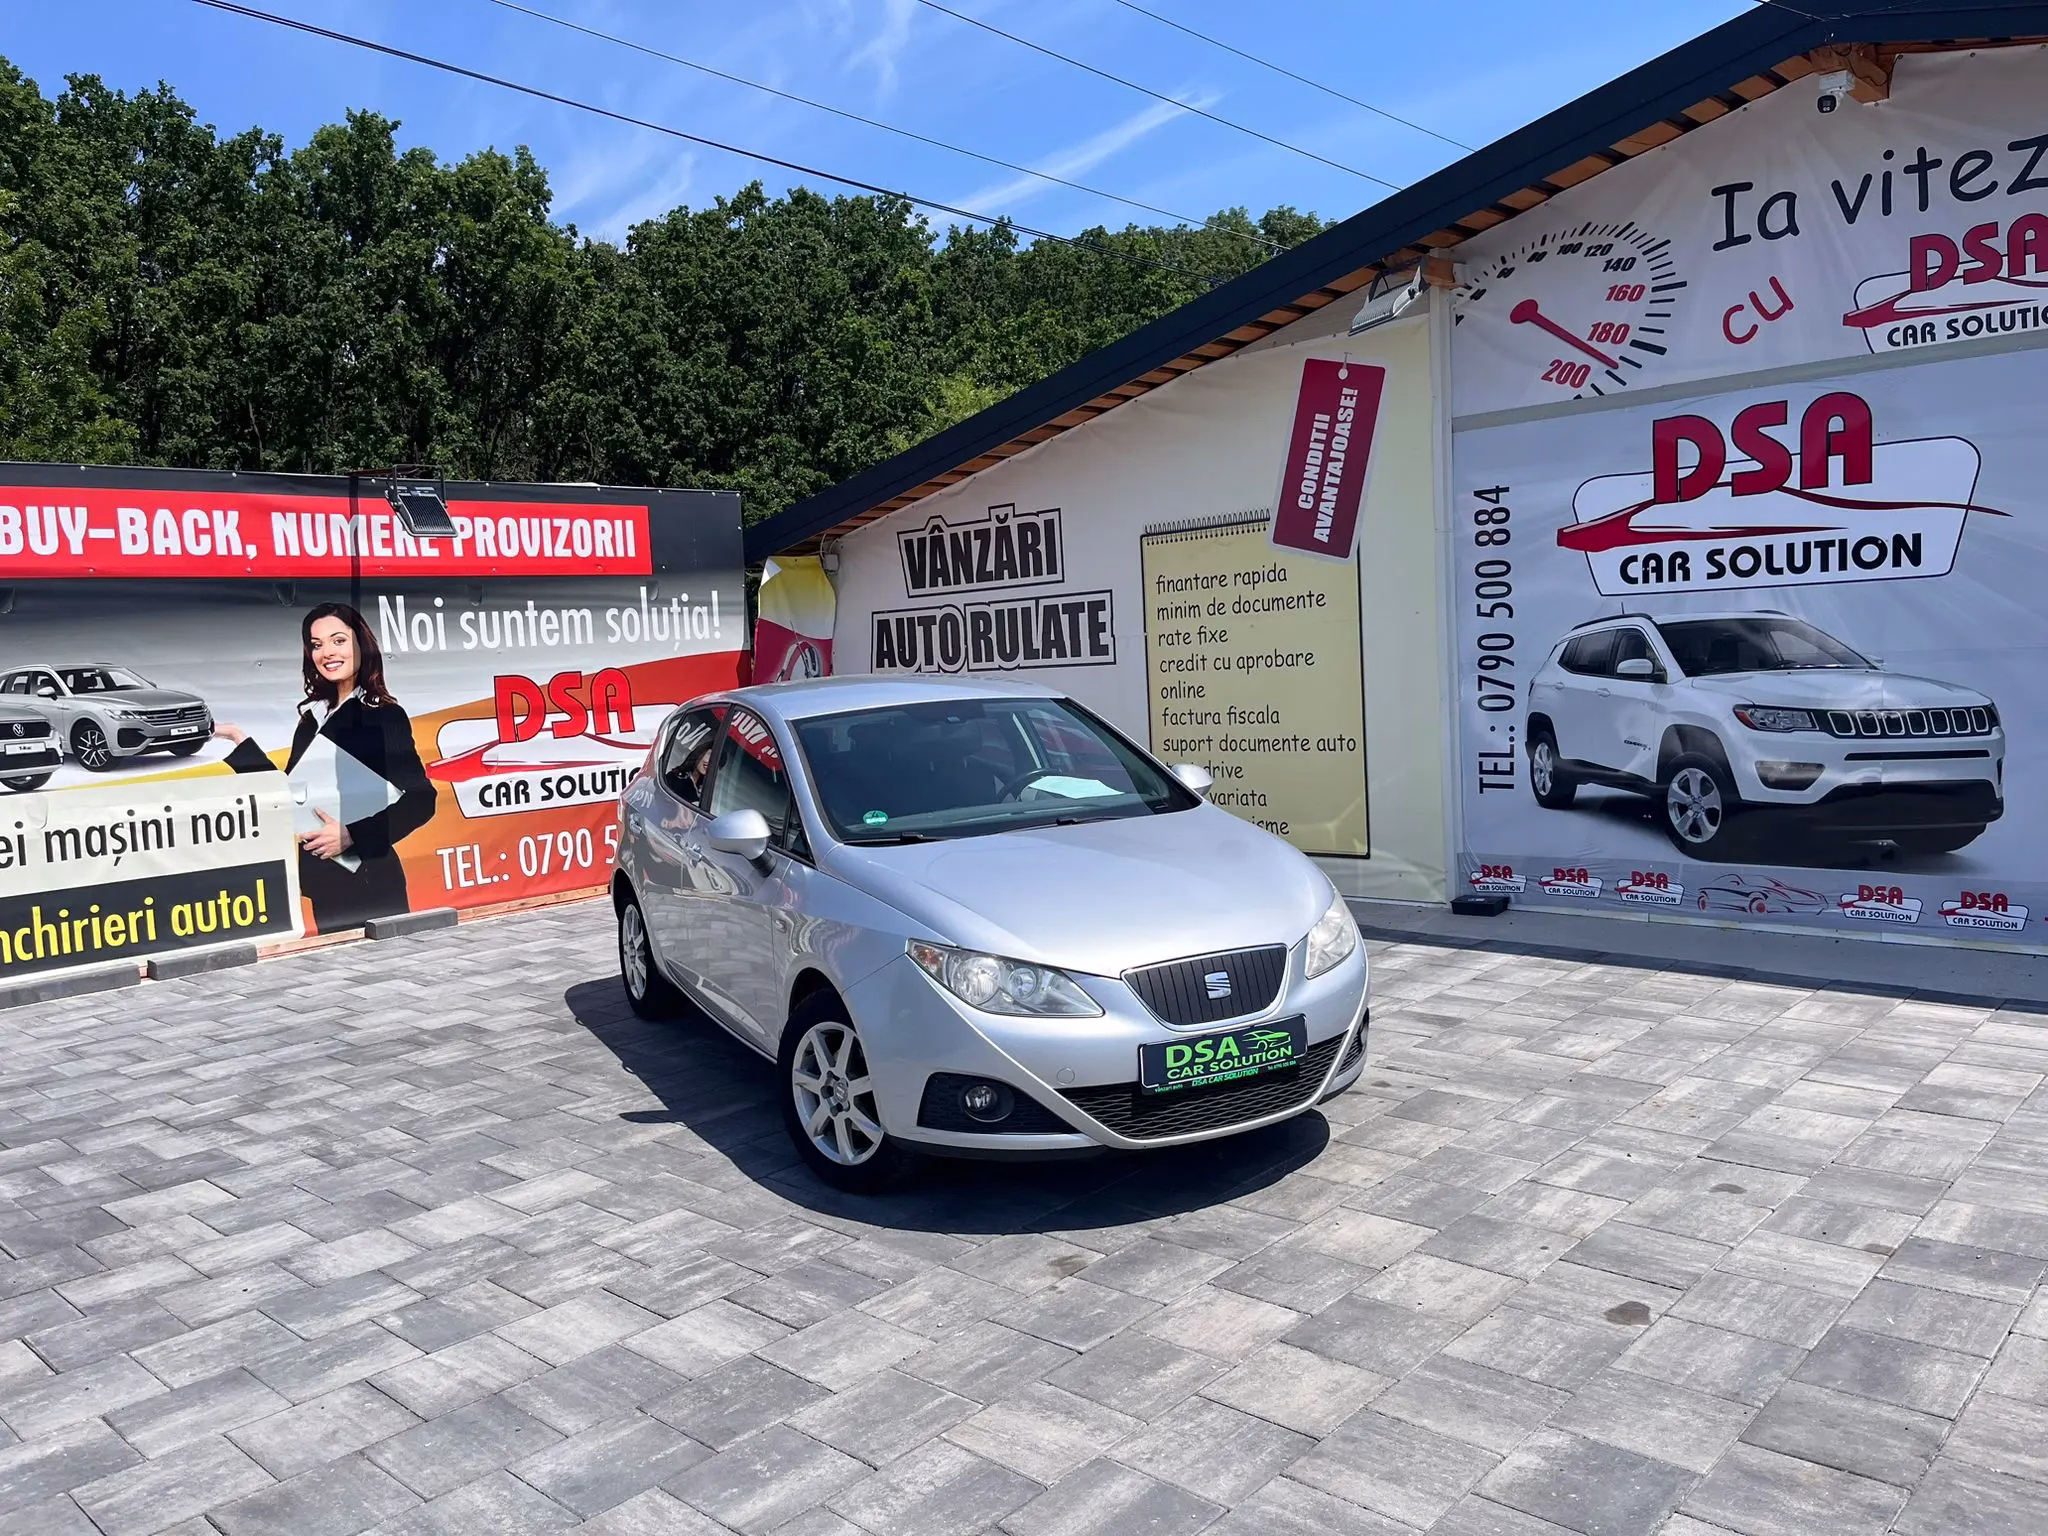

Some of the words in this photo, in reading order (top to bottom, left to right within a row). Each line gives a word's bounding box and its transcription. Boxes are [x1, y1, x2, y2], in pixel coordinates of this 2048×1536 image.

[1711, 181, 1800, 252] Ia
[1557, 241, 1584, 255] 100
[1583, 243, 1614, 258] 120
[1909, 213, 2048, 292] DSA
[1602, 256, 1637, 272] 140
[1605, 284, 1646, 302] 160
[1722, 275, 1794, 345] cu
[1587, 321, 1631, 345] 180
[1886, 324, 1937, 347] CAR
[1540, 359, 1591, 389] 200
[1297, 413, 1331, 510] CONDITII
[1652, 391, 1873, 504] DSA
[1313, 387, 1359, 543] AVANTAJOASE!
[1473, 485, 1511, 547] 884
[453, 515, 637, 559] PROVIZORII
[903, 512, 1058, 590] VÂNZĂRI
[1618, 551, 1691, 585] CAR
[1706, 532, 1922, 580] SOLUTION
[1155, 571, 1228, 595] finantare
[1233, 562, 1288, 590] rapida
[1474, 559, 1514, 619] 500
[378, 594, 449, 653] Noi
[459, 600, 594, 650] suntem
[606, 585, 722, 653] soluția!
[1157, 601, 1202, 621] minim
[1206, 597, 1227, 616] de
[1232, 590, 1326, 615] documente
[875, 612, 961, 669] AUTO
[969, 599, 1110, 663] RULATE
[1158, 628, 1193, 647] rate
[1196, 625, 1229, 645] fixe
[1159, 653, 1208, 673] credit
[1213, 655, 1231, 671] cu
[1236, 649, 1315, 675] aprobare
[1477, 632, 1516, 712] 0790
[1160, 680, 1206, 700] online
[494, 667, 636, 744] DSA
[1162, 707, 1221, 726] factura
[1226, 704, 1280, 726] fiscala
[1163, 736, 1213, 757] suport
[1219, 733, 1311, 752] documente
[1316, 734, 1357, 752] auto
[478, 779, 531, 808] CAR
[1209, 789, 1268, 807] variata
[191, 794, 261, 845] noi!
[518, 827, 594, 878] 0790
[1480, 864, 1513, 879] DSA
[1553, 868, 1589, 884] DSA
[1631, 870, 1669, 889] DSA
[1478, 884, 1492, 892] CAR
[1493, 884, 1521, 892] SOLUTION
[1548, 887, 1561, 895] CAR
[1562, 888, 1596, 897] SOLUTION
[1625, 894, 1640, 902] CAR
[1641, 894, 1677, 904] SOLUTION
[1858, 884, 1903, 905] DSA
[1960, 891, 2009, 913] DSA
[171, 878, 269, 938] auto!
[1850, 909, 1867, 918] CAR
[1868, 910, 1912, 921] SOLUTION
[1952, 917, 1970, 926] CAR
[1971, 918, 2018, 929] SOLUTION
[1165, 1036, 1240, 1069] DSA
[1166, 1064, 1204, 1079] CAR
[1209, 1046, 1292, 1072] SOLUTION
[1192, 1078, 1208, 1087] DSA
[1208, 1074, 1223, 1084] CAR
[1224, 1068, 1259, 1081] SOLUTION
